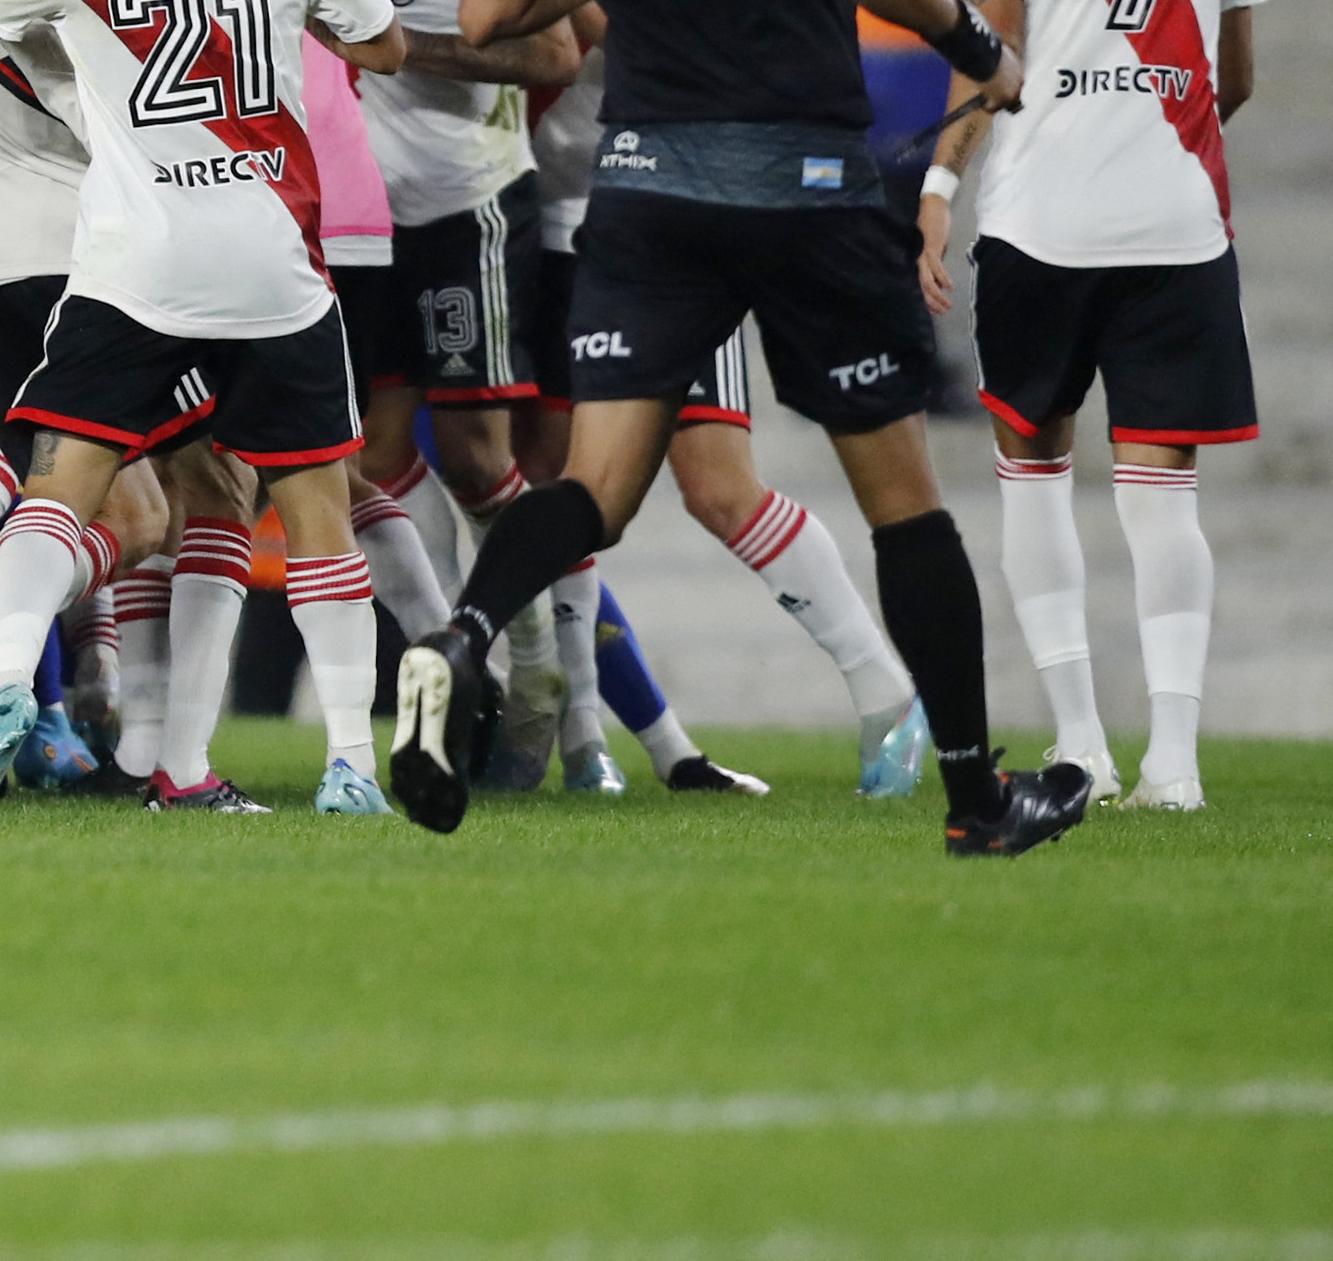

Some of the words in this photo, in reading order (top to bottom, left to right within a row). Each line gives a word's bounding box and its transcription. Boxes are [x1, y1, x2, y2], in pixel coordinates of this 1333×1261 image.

[1054, 66, 1192, 101] DIRECTV
[416, 285, 478, 355] 13
[570, 331, 632, 361] TCL
[828, 352, 900, 390] TCL
